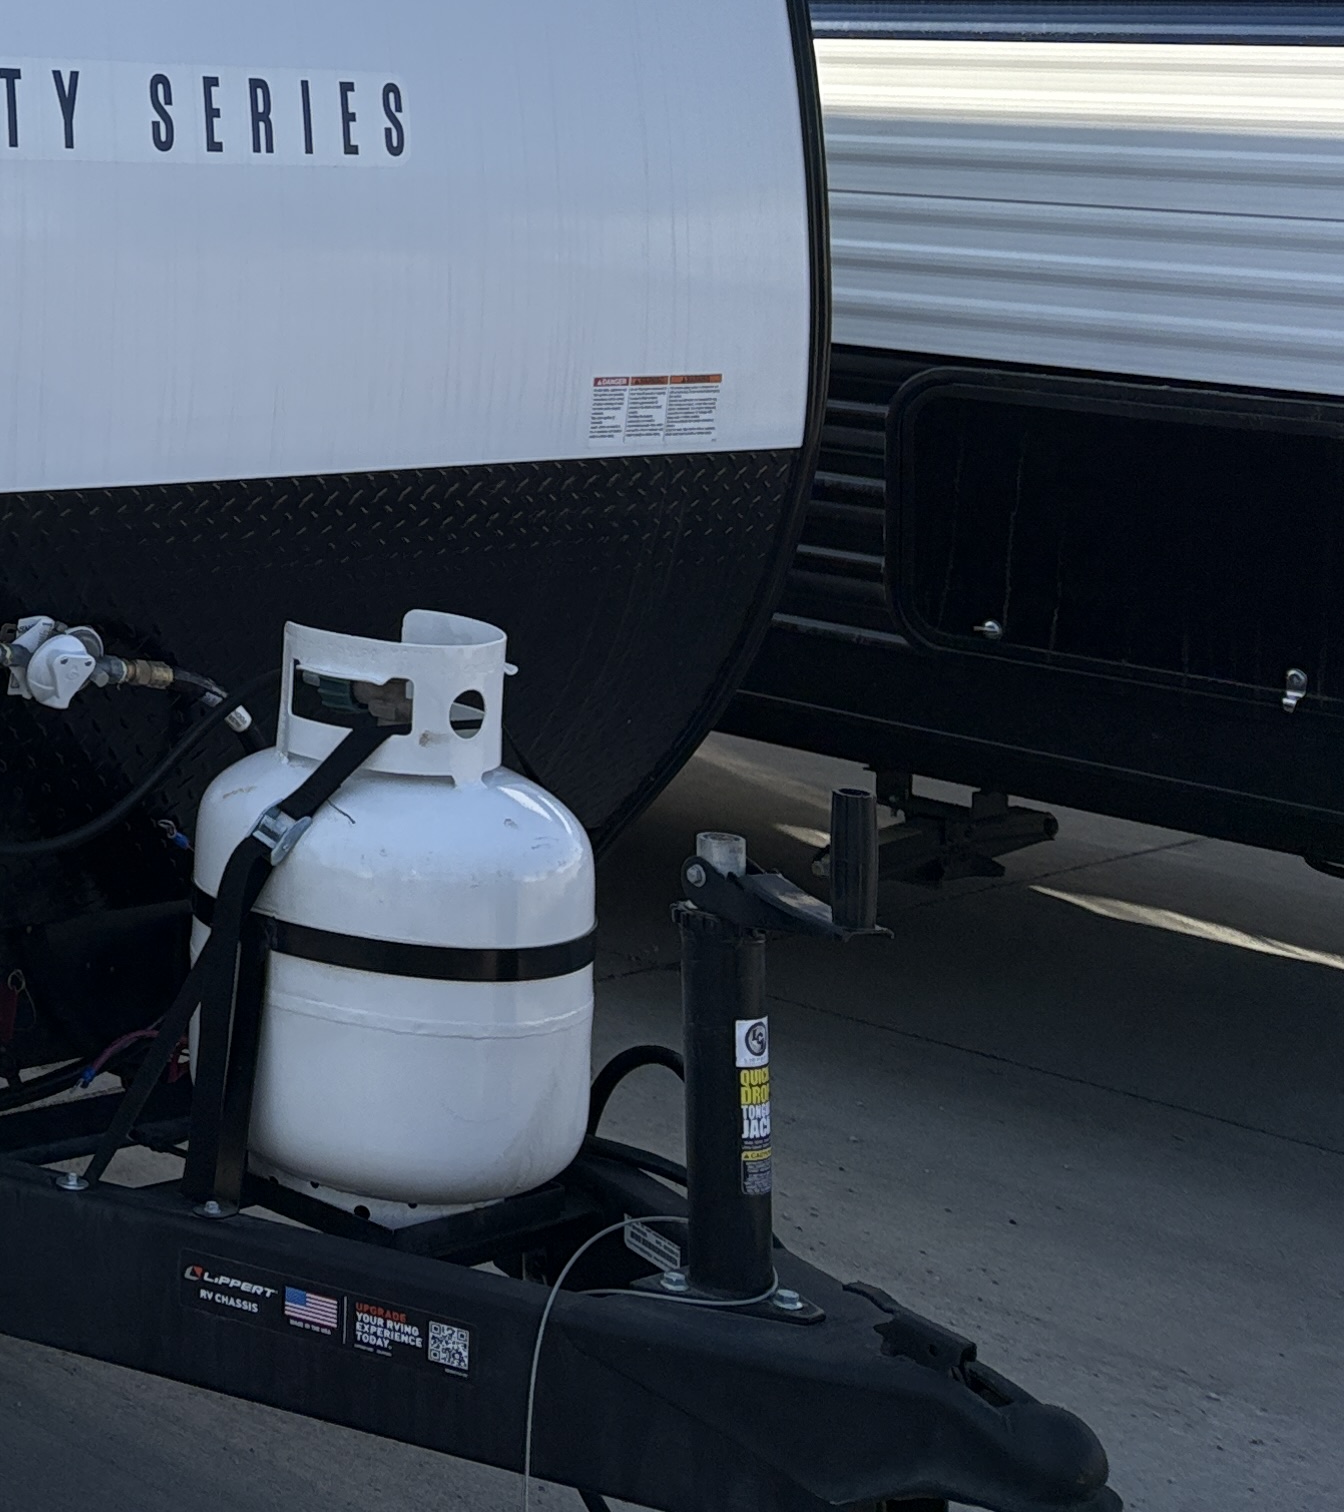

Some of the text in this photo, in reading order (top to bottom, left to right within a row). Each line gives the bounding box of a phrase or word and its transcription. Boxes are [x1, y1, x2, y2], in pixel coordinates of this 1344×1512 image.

[149, 73, 406, 157] SERIES
[199, 1289, 259, 1313] RV CHASSIS
[355, 1301, 407, 1324] UPGRADE
[355, 1312, 419, 1337] YOUR RVING
[355, 1321, 423, 1349] EXPERIENCE
[355, 1331, 393, 1350] TODAY.
